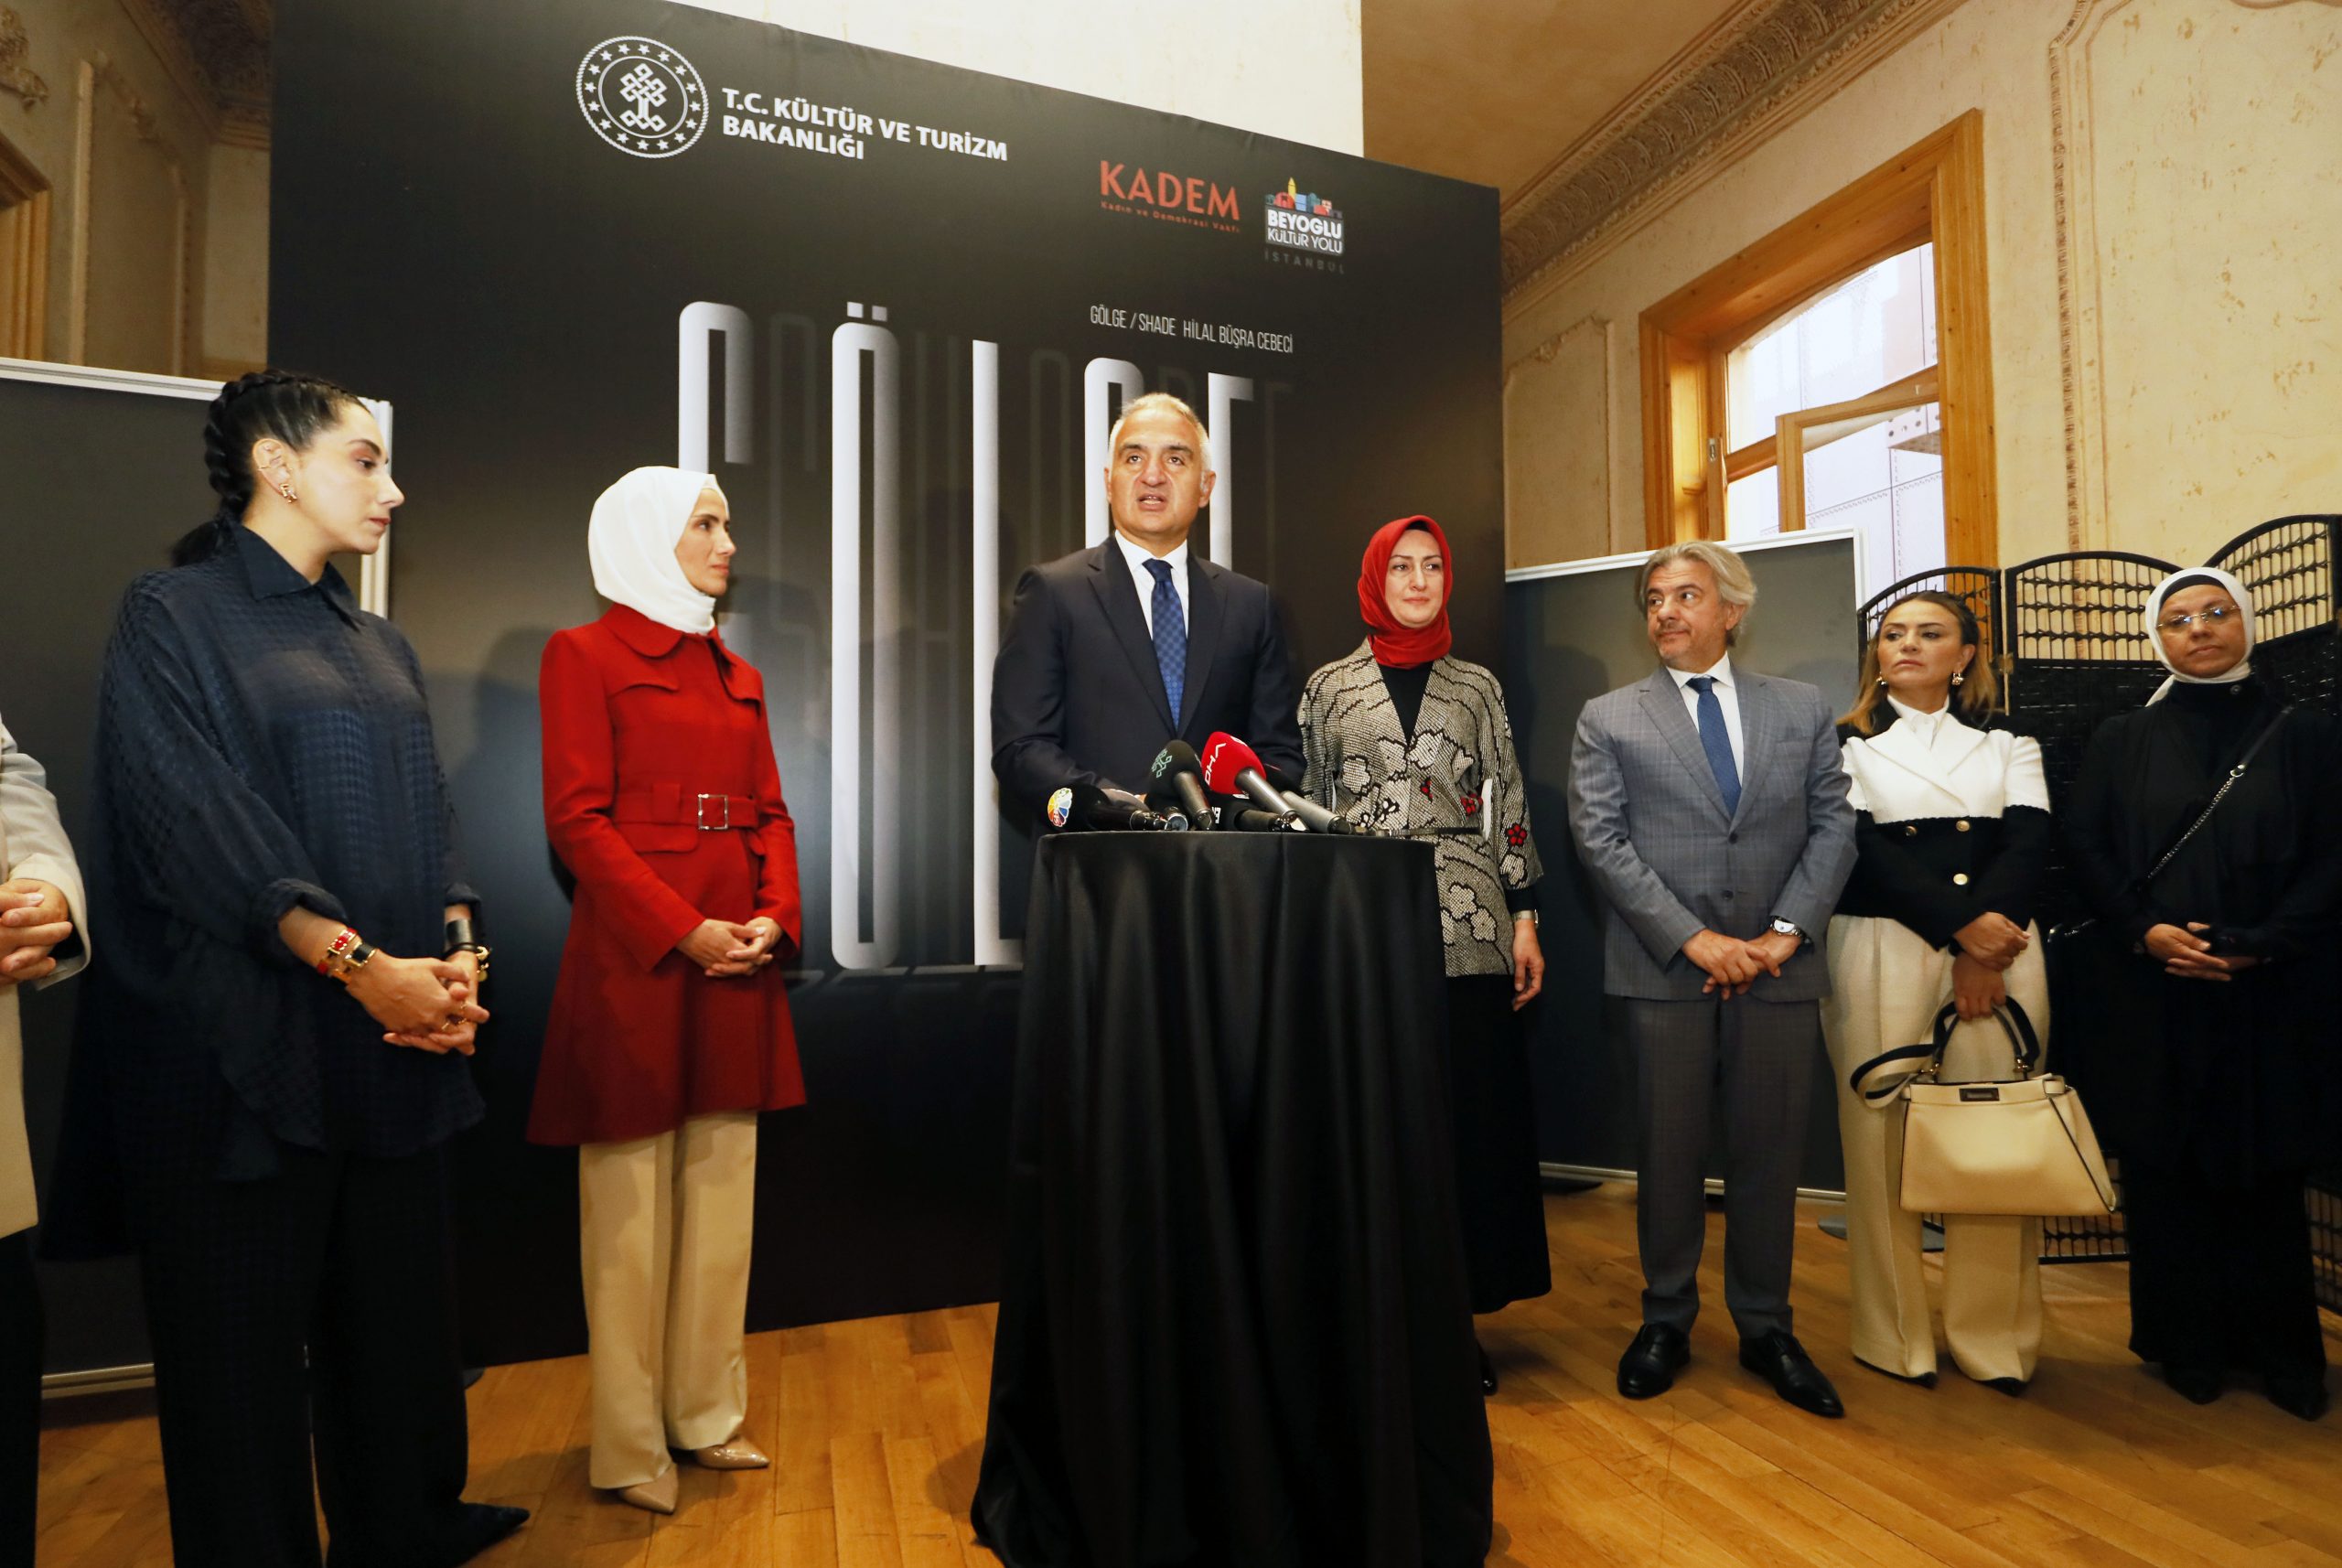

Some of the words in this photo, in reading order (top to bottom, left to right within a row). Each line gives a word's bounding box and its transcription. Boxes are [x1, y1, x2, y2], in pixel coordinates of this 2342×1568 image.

[722, 88, 768, 114] T.C.
[774, 97, 873, 134] KÜLTÜR
[878, 119, 910, 143] VE
[916, 126, 1007, 161] TURİZM
[723, 115, 864, 159] BAKANLIĞI
[1101, 160, 1240, 220] KADEM
[1267, 228, 1308, 247] KÜLTÜR
[1311, 235, 1342, 253] YOLU
[1090, 304, 1127, 328] GÖLGE
[1183, 318, 1217, 342] HİLAL
[1219, 324, 1255, 349] BÜŞRA
[1257, 333, 1293, 353] CEBECİ
